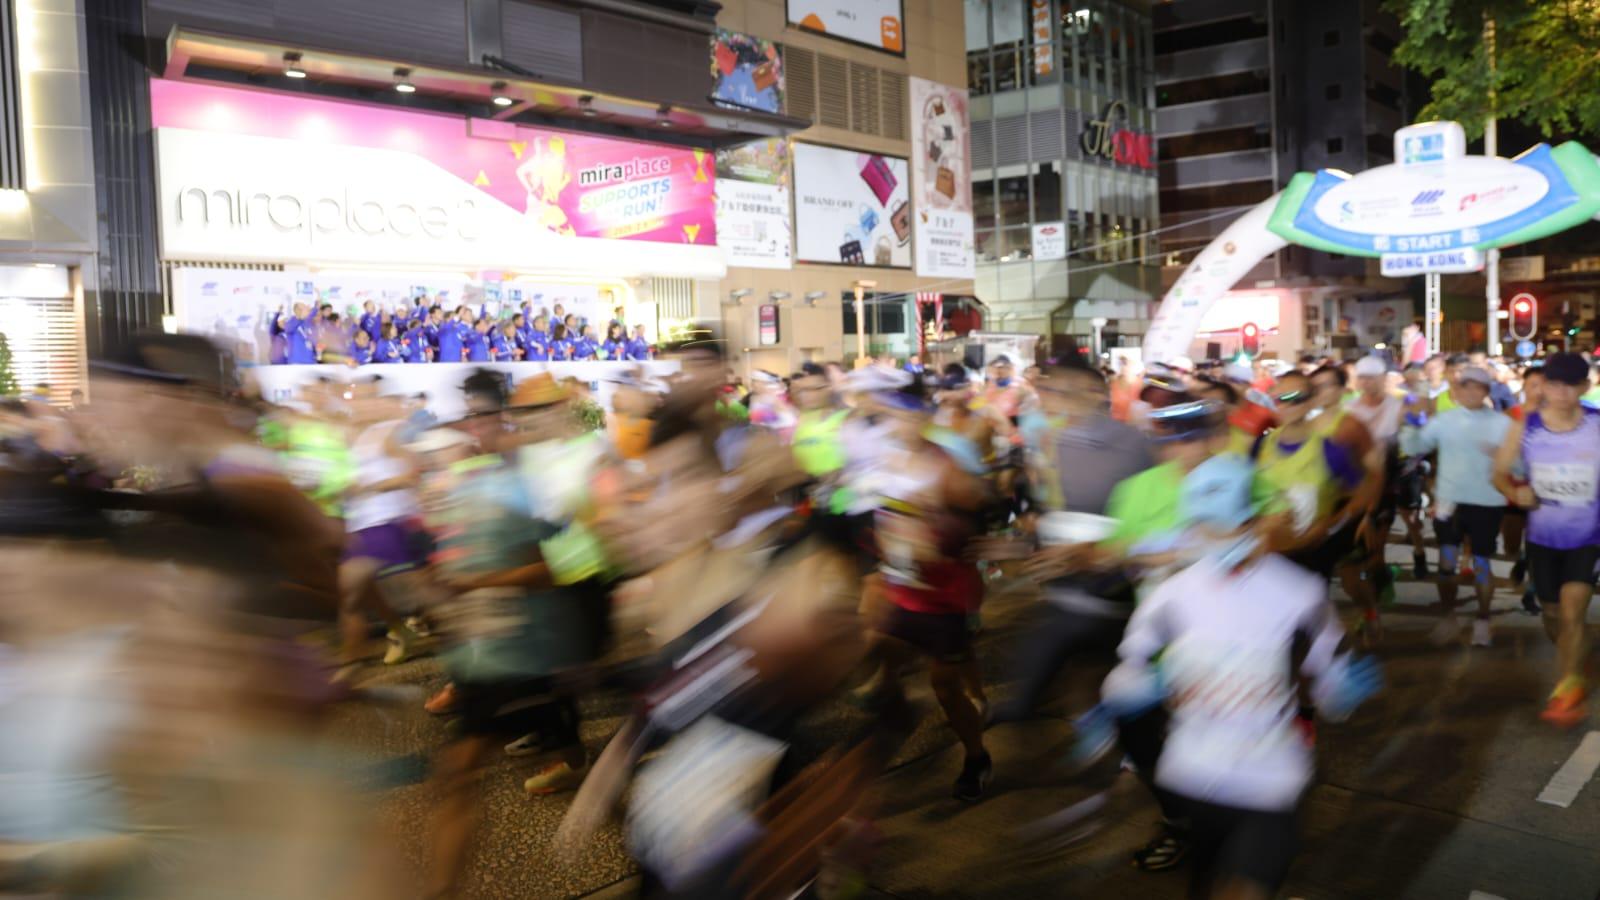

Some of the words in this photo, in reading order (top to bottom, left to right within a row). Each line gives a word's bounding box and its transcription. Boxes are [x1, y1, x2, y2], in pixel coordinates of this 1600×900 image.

[581, 158, 669, 184] miraplace
[582, 178, 671, 211] SUPPORTS
[175, 184, 448, 246] miraplace
[1397, 232, 1452, 251] START
[1385, 256, 1424, 270] HONG
[1428, 251, 1466, 267] KONG
